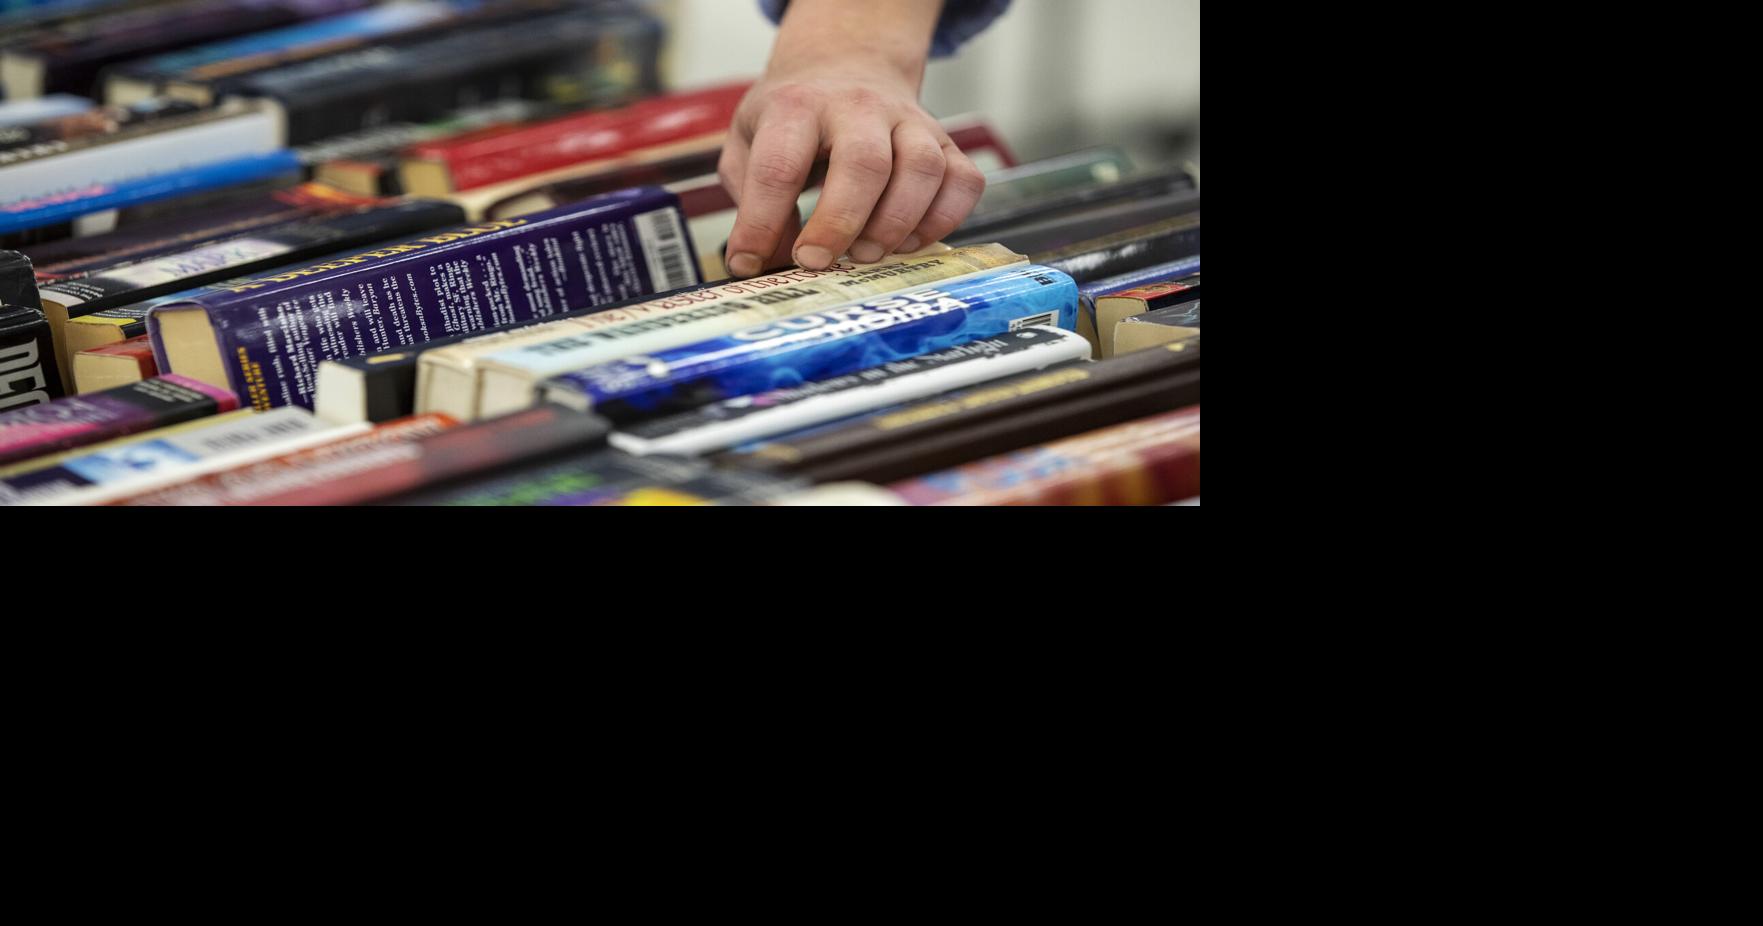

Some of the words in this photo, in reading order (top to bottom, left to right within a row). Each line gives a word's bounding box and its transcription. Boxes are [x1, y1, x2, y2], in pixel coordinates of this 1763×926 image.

[429, 266, 435, 275] to
[444, 262, 457, 287] Ringo
[452, 260, 460, 274] the
[460, 258, 474, 289] Weekly
[381, 277, 389, 288] he
[389, 275, 397, 289] the
[432, 278, 442, 296] plot
[438, 272, 451, 299] makes
[457, 276, 465, 293] that
[283, 301, 291, 310] of
[308, 294, 320, 313] gets
[316, 293, 325, 307] the
[324, 291, 334, 309] find
[341, 287, 356, 318] Weekly
[357, 283, 368, 306] leave
[365, 282, 381, 315] Baryon
[386, 290, 392, 299] as
[452, 290, 460, 302] SF,
[257, 307, 269, 327] with
[330, 311, 340, 328] will
[364, 309, 374, 325] will
[388, 302, 400, 326] death
[394, 291, 410, 331] threatens
[405, 272, 431, 343] ooksnBytes.com
[438, 298, 453, 332] jihadist
[448, 302, 460, 330] Ghost,
[456, 304, 470, 333] ilitary
[462, 294, 477, 329] warning
[497, 303, 507, 323] from
[733, 288, 951, 341] CURSE
[831, 296, 972, 338] MOIRA
[286, 312, 300, 341] author
[291, 298, 311, 345] Vengeance
[313, 315, 324, 334] who
[321, 309, 340, 355] witnessing
[375, 316, 390, 349] Hunter,
[263, 329, 276, 353] filled
[320, 337, 329, 351] life
[335, 330, 349, 359] reader
[350, 321, 365, 356] blishers
[370, 327, 379, 344] and
[396, 328, 405, 345] and
[237, 345, 253, 383] SERIES
[270, 354, 284, 378] rush,
[295, 342, 315, 392] Best-Selling
